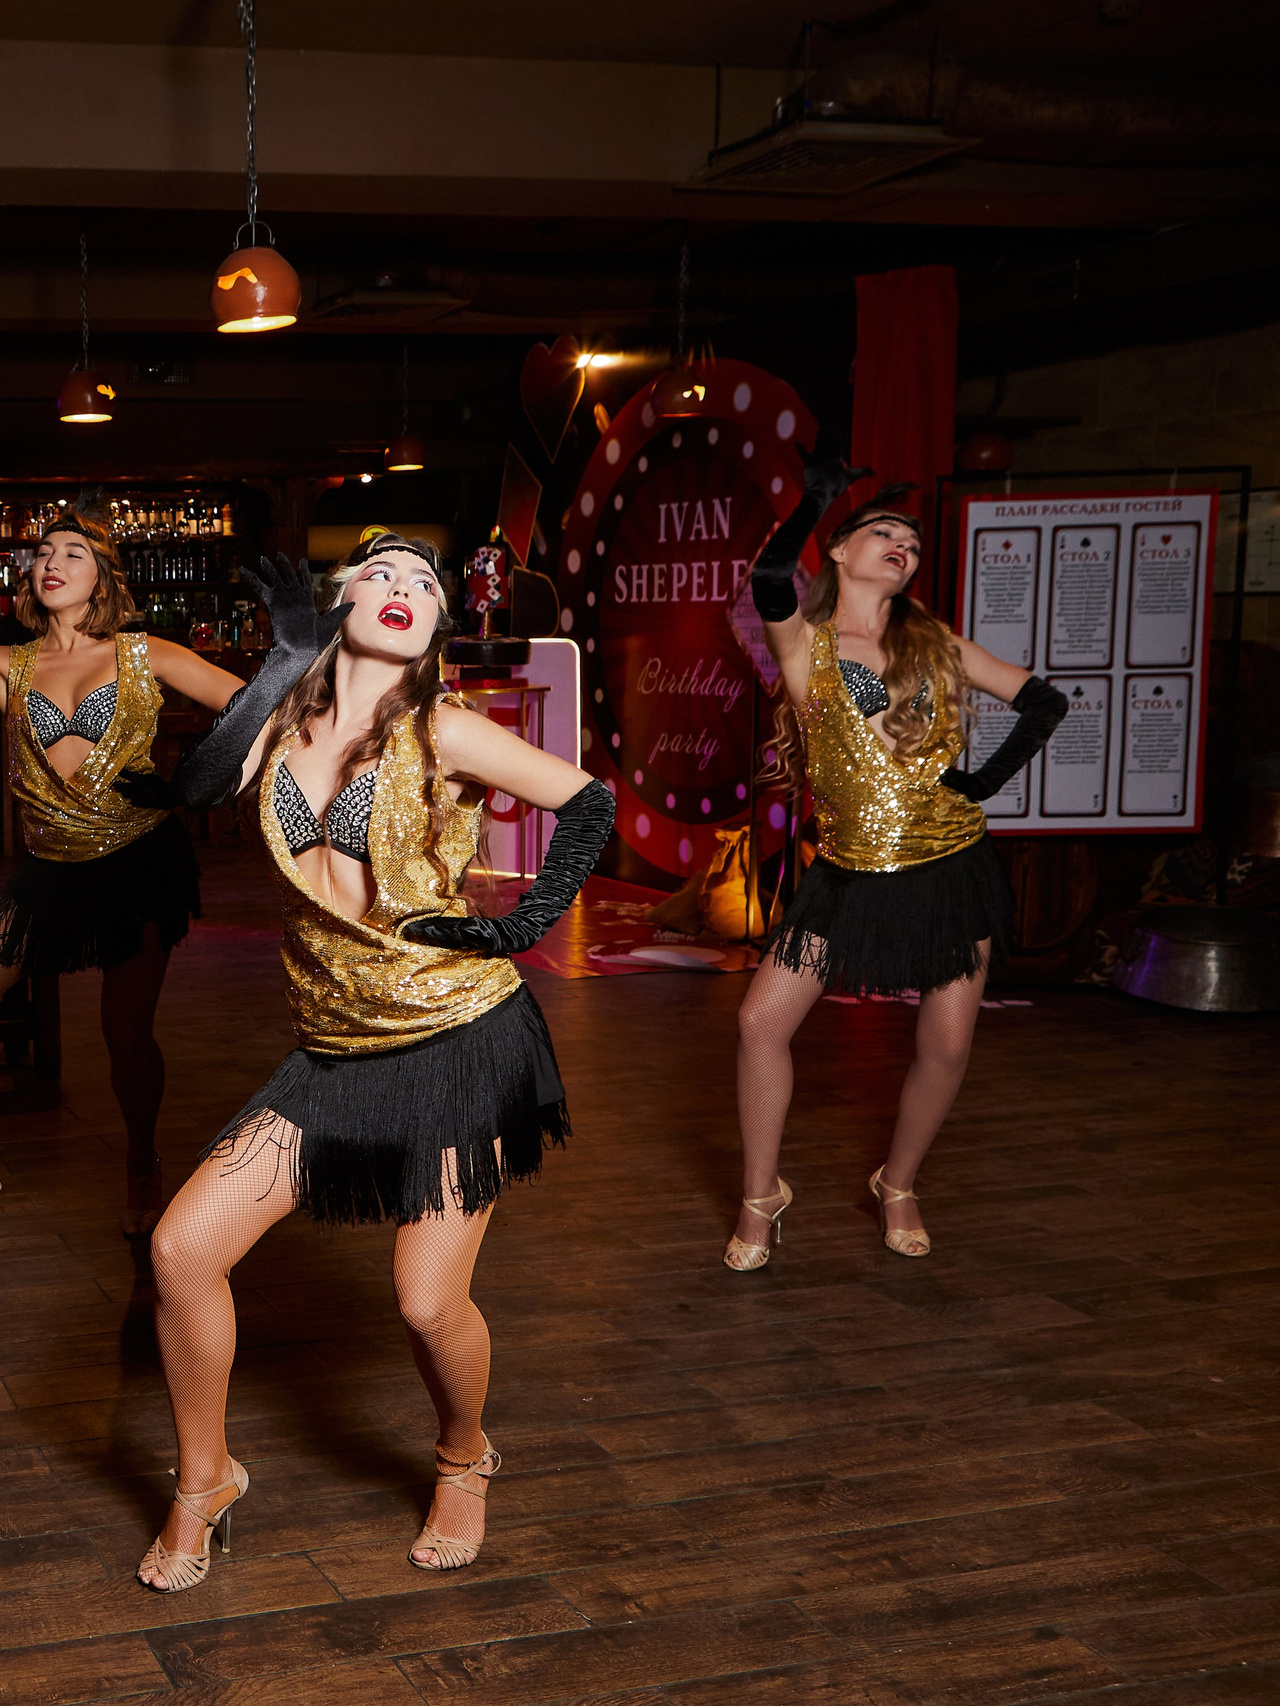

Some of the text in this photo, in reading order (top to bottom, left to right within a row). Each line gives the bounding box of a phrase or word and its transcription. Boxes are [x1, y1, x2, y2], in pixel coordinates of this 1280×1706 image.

[994, 499, 1182, 517] ПЛАН РАССАДКИ ГОСТЕЙ
[658, 497, 732, 543] IVAN
[981, 553, 1021, 565] СТОЛ
[1059, 551, 1112, 562] СТОЛ 2
[1139, 548, 1192, 560] СТОЛ 3
[637, 658, 745, 713] Birthday
[1095, 700, 1104, 710] 5
[1131, 698, 1183, 710] СТОЛ 6
[648, 728, 719, 770] party
